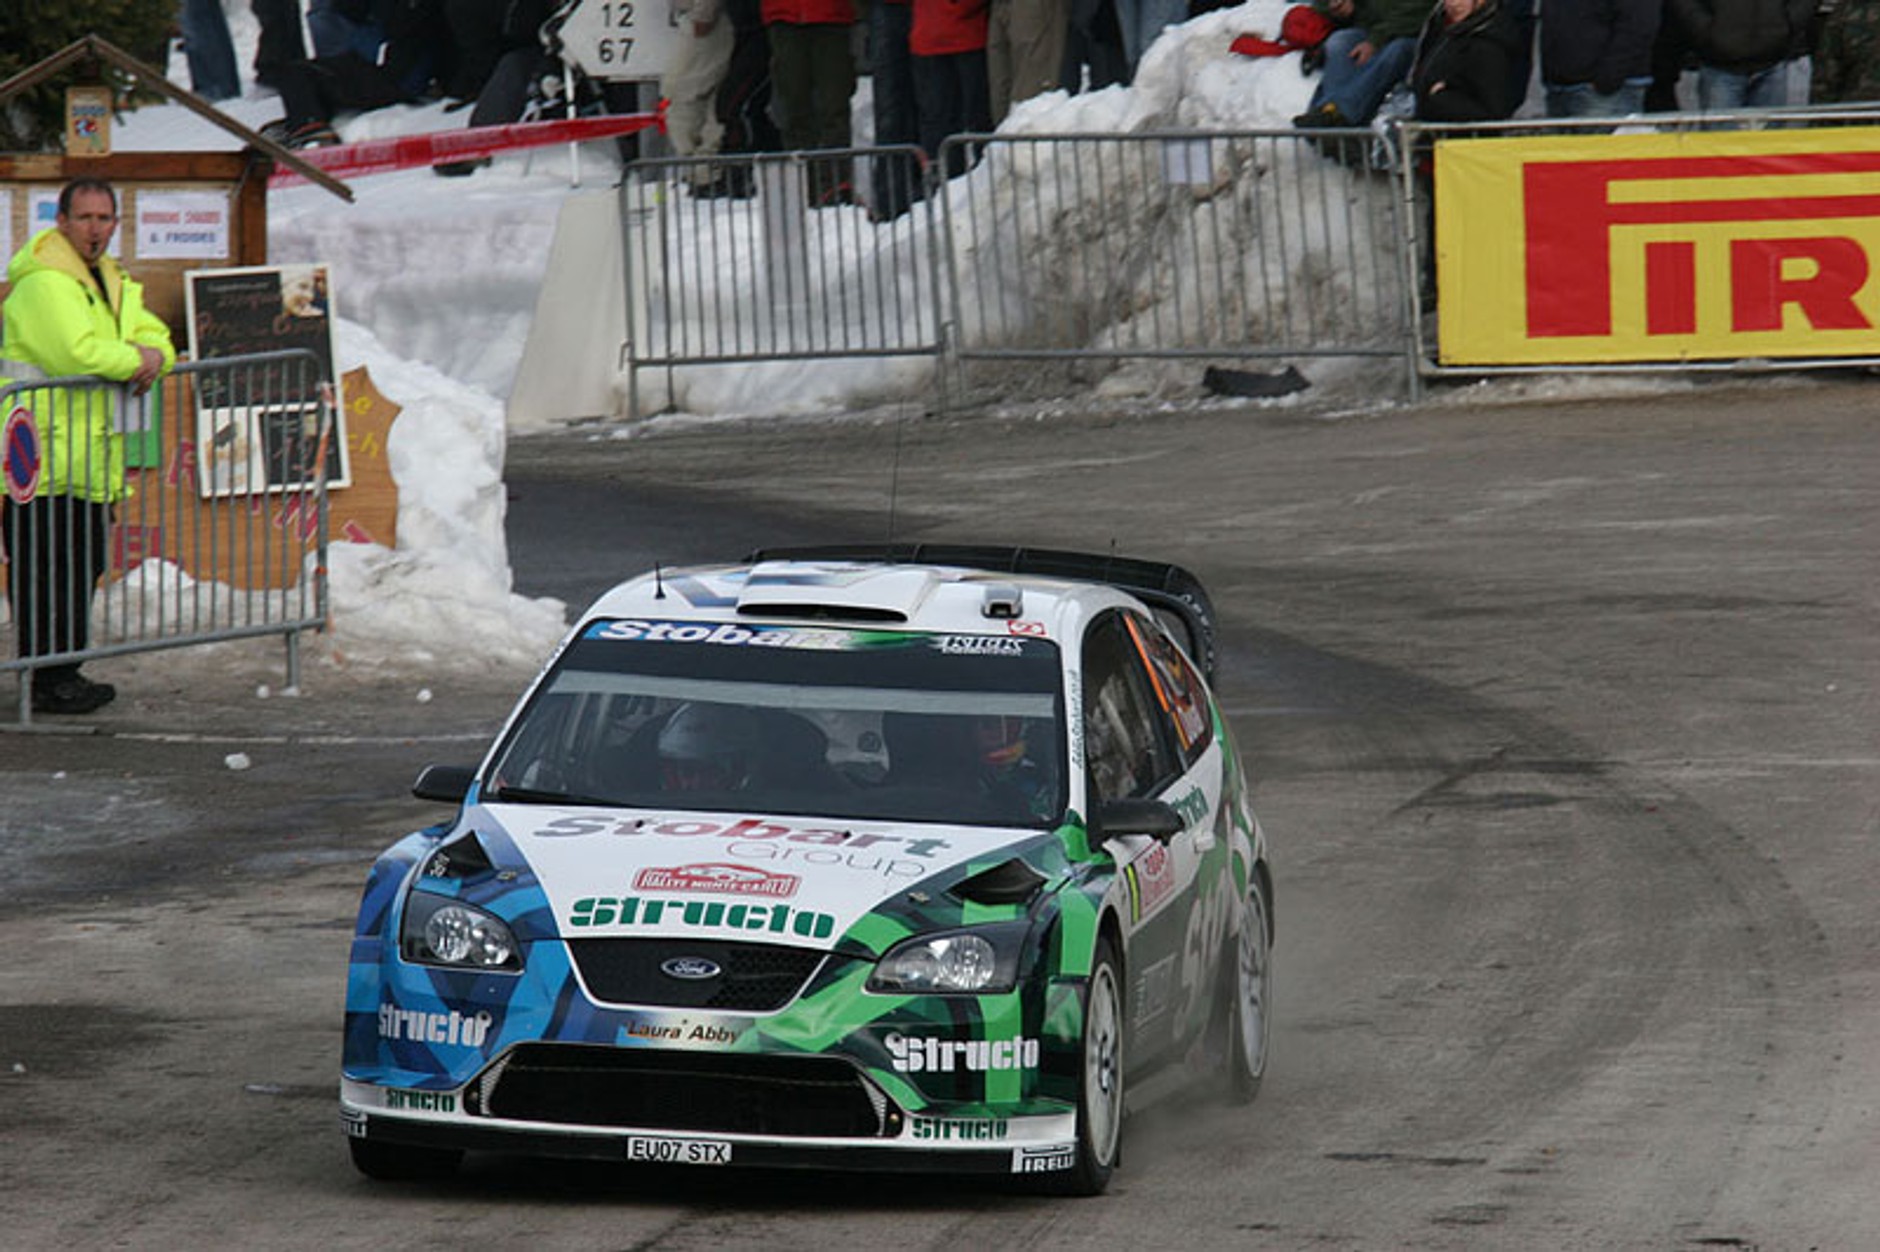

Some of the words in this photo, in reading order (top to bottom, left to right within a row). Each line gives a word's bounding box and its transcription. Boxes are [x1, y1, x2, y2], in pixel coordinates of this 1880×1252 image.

[602, 3, 634, 27] 12
[599, 38, 634, 63] 67
[599, 620, 851, 650] Stobart
[533, 815, 951, 858] Stobart
[726, 841, 926, 877] Group
[673, 959, 707, 975] Ford
[627, 1020, 682, 1039] Laura
[689, 1024, 736, 1045] Abby
[633, 1140, 682, 1160] EU07
[688, 1143, 725, 1163] STX
[1011, 1144, 1074, 1173] PIRELLI
